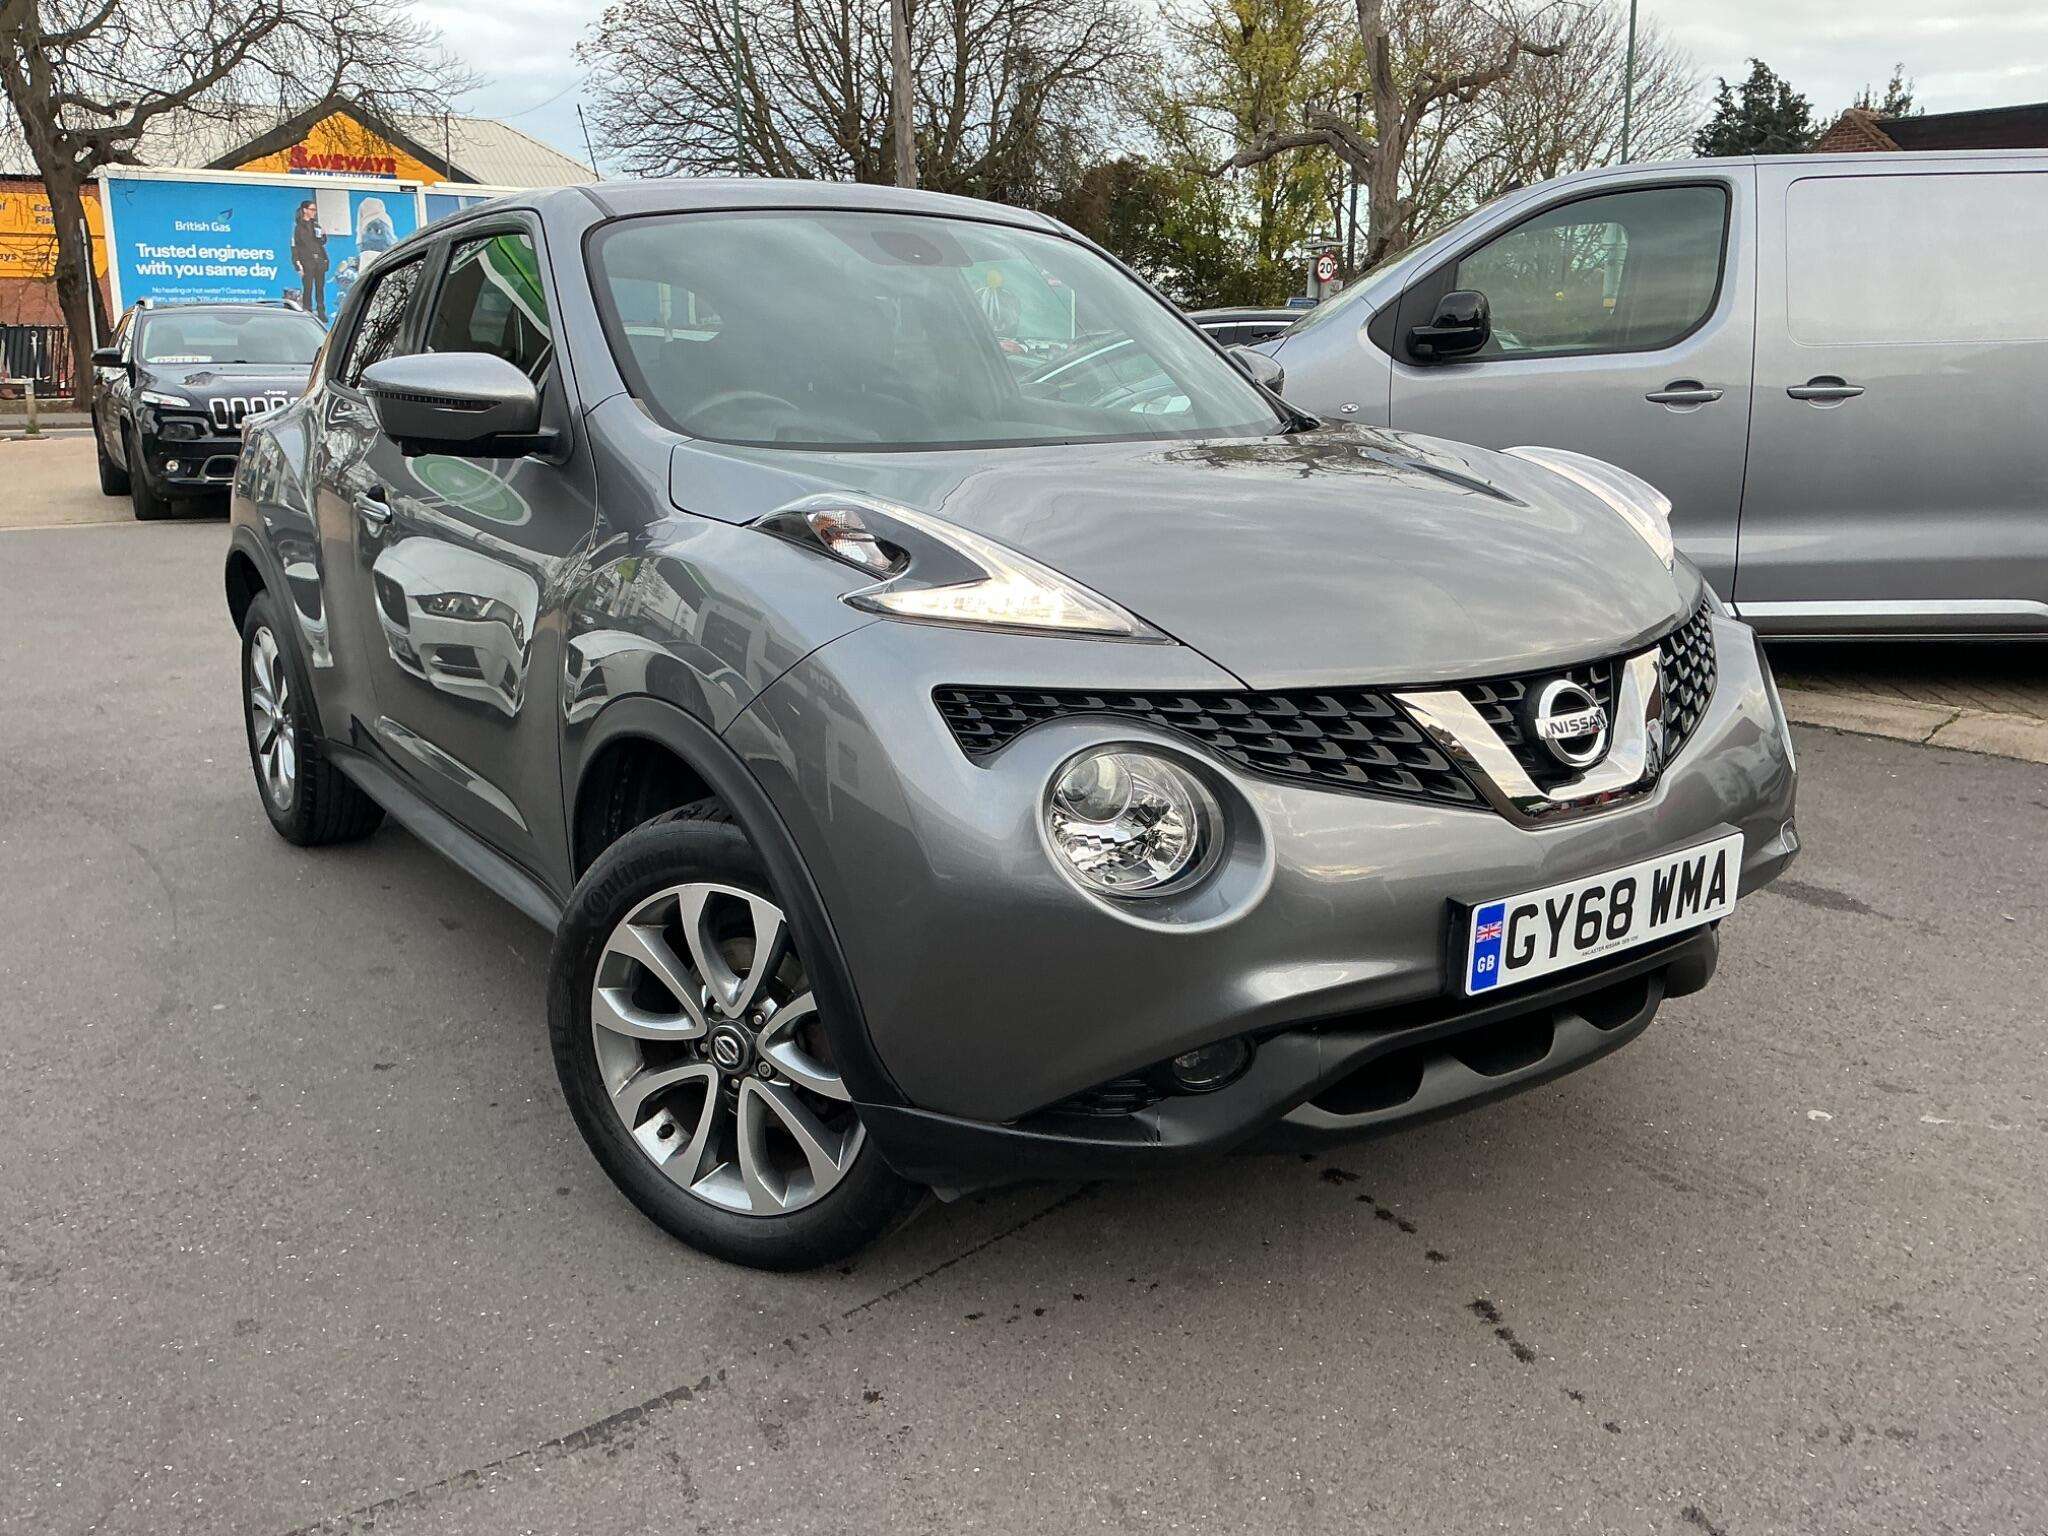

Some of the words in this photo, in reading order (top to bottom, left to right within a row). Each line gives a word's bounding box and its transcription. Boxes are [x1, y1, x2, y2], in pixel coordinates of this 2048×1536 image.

[175, 221, 209, 232] British
[211, 221, 231, 233] Gas
[135, 243, 197, 258] Trusted
[198, 244, 275, 262] engineers
[136, 260, 172, 275] with
[174, 264, 204, 279] you
[205, 265, 248, 277] same
[249, 263, 278, 280] day
[1320, 262, 1332, 274] 20
[1549, 709, 1606, 735] NISSAN
[1505, 877, 1637, 970] GY68
[1649, 849, 1726, 928] WMA
[1477, 954, 1495, 973] GB
